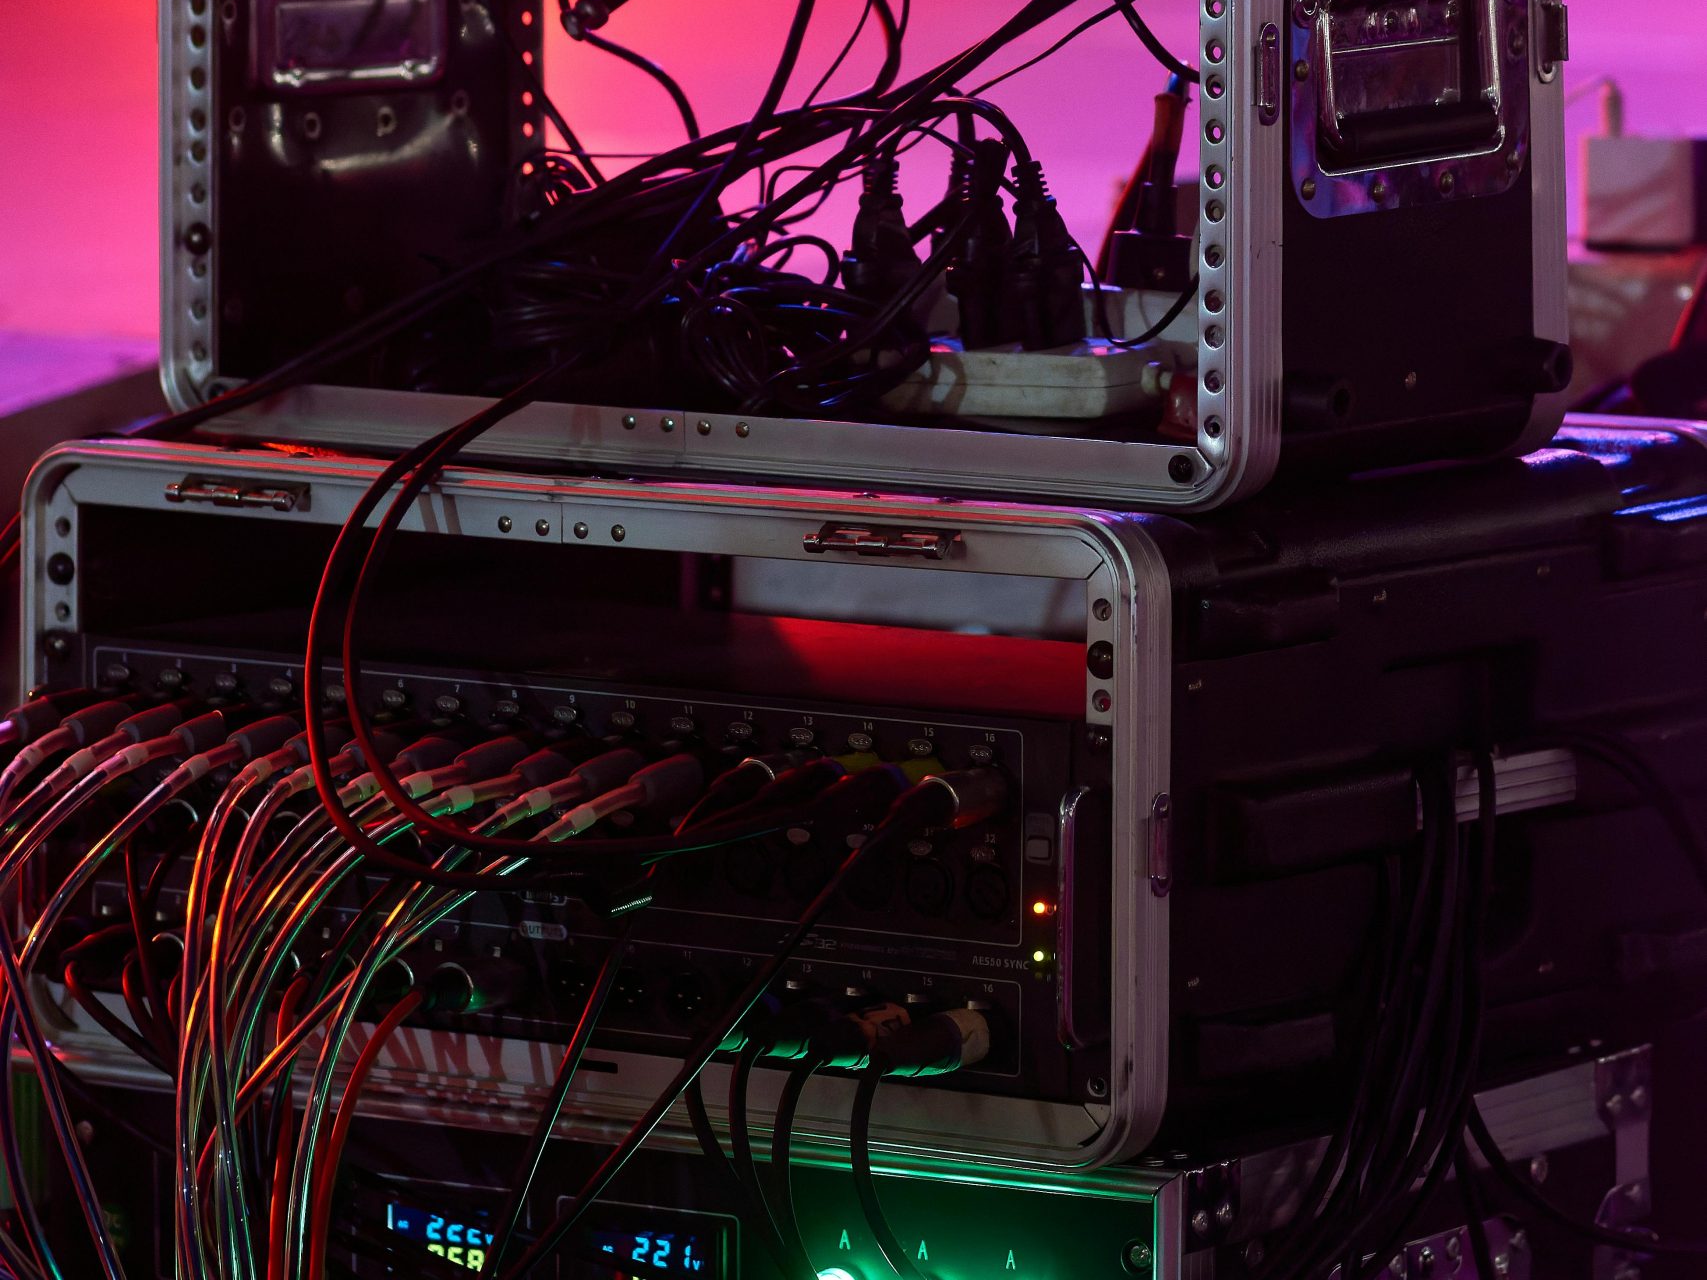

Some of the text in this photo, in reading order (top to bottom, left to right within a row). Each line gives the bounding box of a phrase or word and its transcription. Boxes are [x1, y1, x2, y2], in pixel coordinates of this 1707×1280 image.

[454, 684, 461, 694] 7
[568, 694, 575, 704] 9
[625, 699, 636, 710] 10
[683, 704, 694, 715] 11
[743, 710, 753, 721] 12
[802, 716, 814, 727] 13
[862, 721, 874, 732] 14
[923, 726, 935, 737] 15
[984, 732, 996, 743] 16
[972, 955, 1031, 970] AES50 SYNC
[802, 963, 813, 974] 13
[922, 976, 934, 987] 15
[984, 983, 995, 993] 16
[838, 1228, 851, 1251] A
[917, 1239, 929, 1261] A
[1005, 1249, 1017, 1271] A
